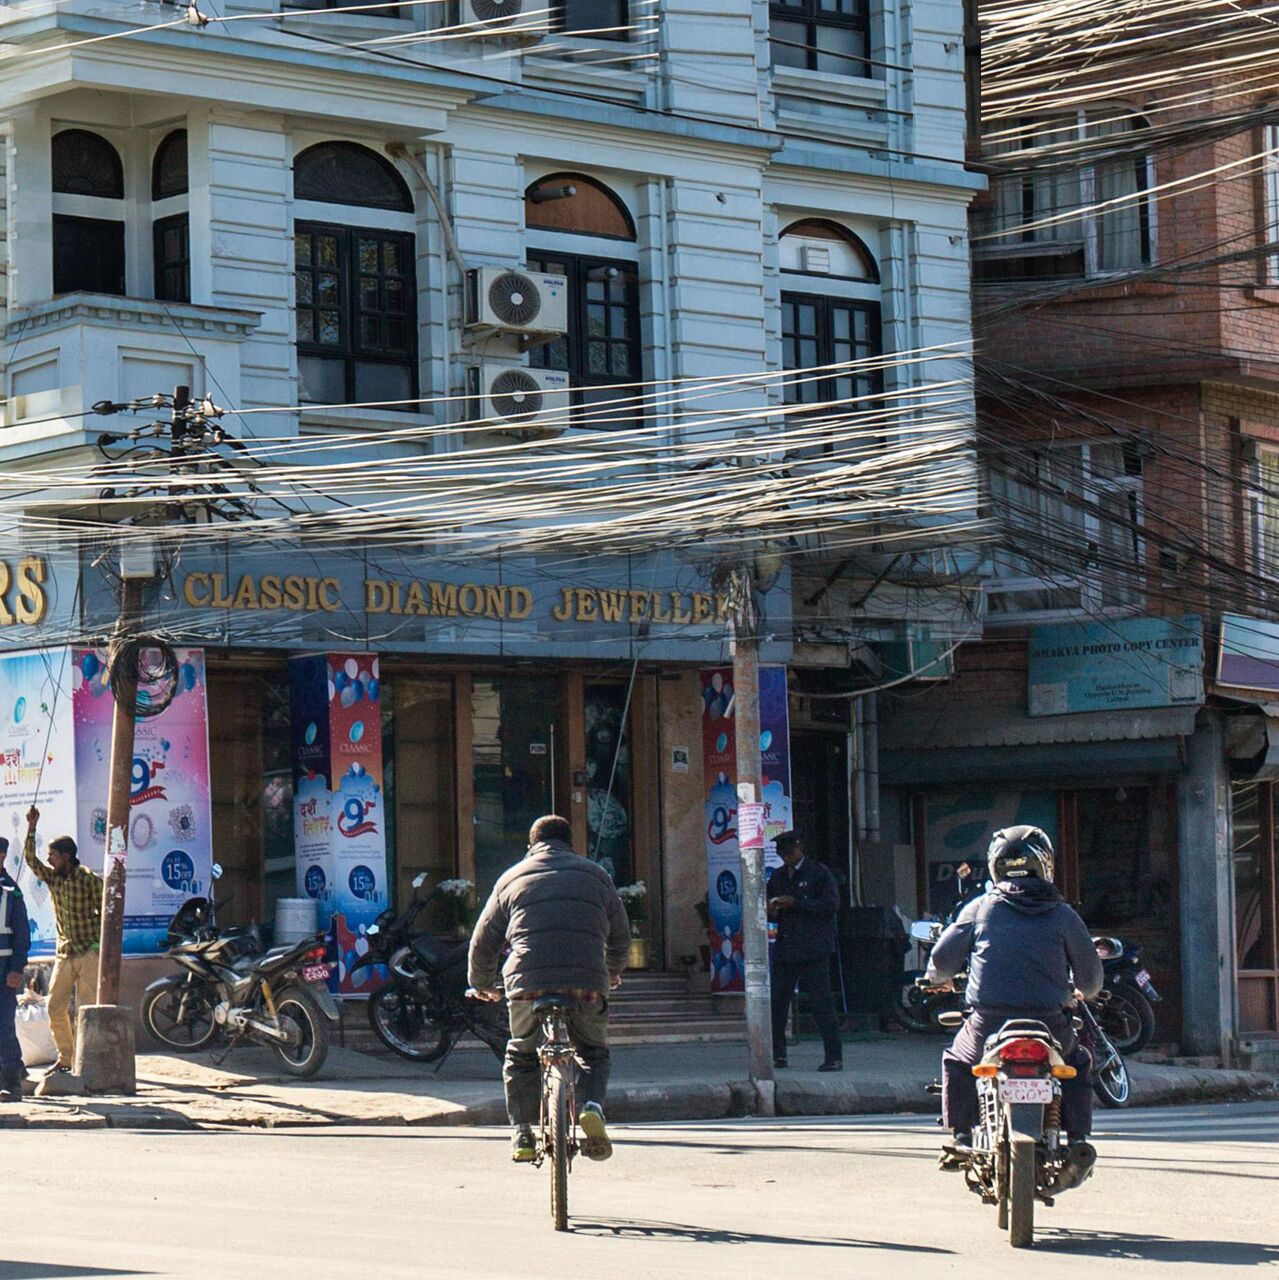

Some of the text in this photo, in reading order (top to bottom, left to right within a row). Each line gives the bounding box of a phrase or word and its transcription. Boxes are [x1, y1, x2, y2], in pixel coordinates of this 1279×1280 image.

[184, 571, 342, 612] CLASSIC
[365, 579, 534, 620] DIAMOND
[1034, 637, 1199, 658] SHAKYA PHOTO COPY CENTER
[340, 743, 371, 753] CLASSIC
